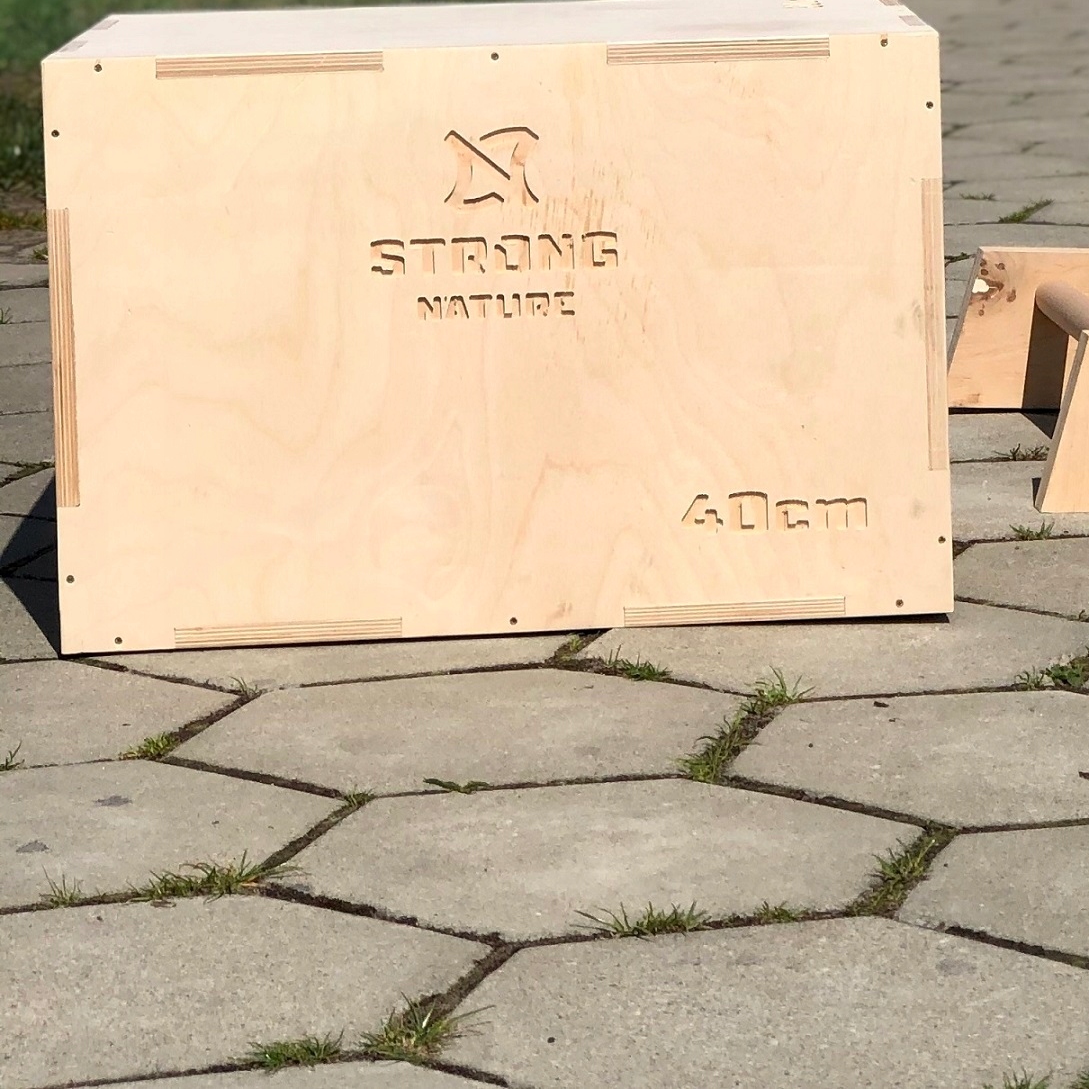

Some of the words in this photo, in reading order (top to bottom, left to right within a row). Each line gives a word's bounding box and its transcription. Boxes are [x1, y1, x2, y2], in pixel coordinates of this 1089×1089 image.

[370, 231, 618, 275] STRONG
[416, 291, 576, 320] NATURE
[681, 490, 868, 534] 40cm
